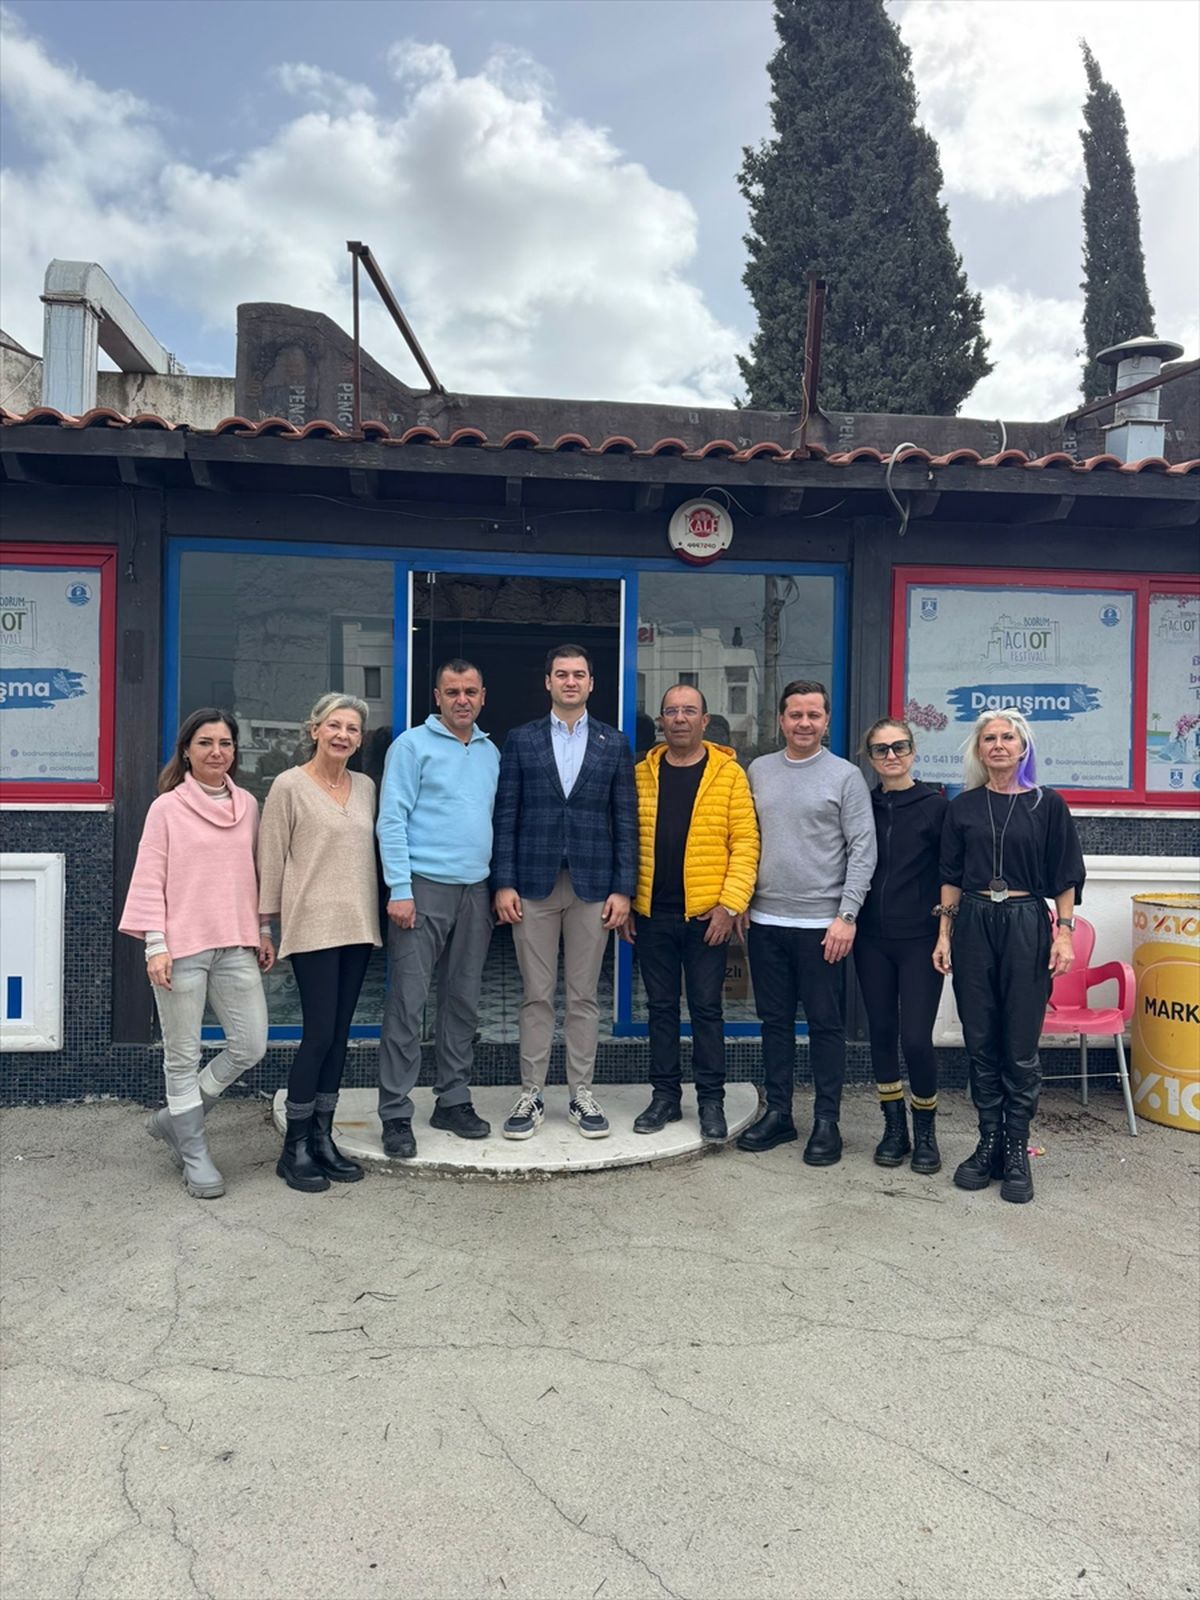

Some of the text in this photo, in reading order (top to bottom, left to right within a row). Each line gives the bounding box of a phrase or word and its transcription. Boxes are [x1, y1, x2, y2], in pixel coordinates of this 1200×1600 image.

[687, 518, 719, 533] KALE
[2, 612, 27, 631] OT
[1023, 616, 1050, 627] BODRUM
[971, 692, 1070, 714] Danışma
[923, 754, 930, 763] 0
[1145, 996, 1200, 1024] MARK
